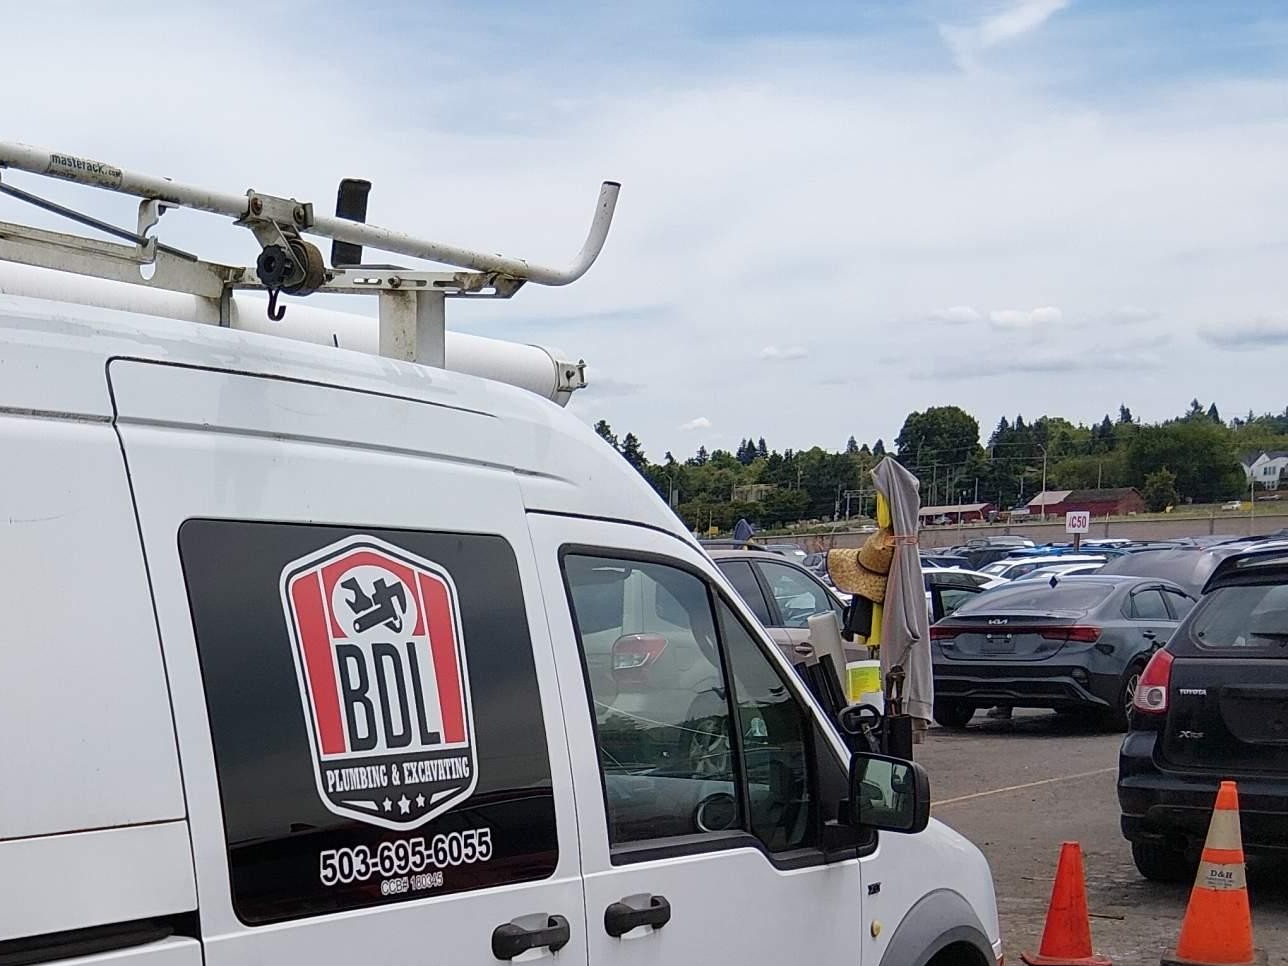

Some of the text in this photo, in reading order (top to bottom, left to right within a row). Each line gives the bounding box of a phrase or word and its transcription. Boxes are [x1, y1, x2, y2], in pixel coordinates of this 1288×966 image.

[336, 642, 441, 752] BDL
[1179, 688, 1207, 696] TOYOTA
[326, 757, 470, 792] PLUMBING & EXCAVATING
[320, 828, 492, 886] 503-695-6055
[381, 871, 443, 895] CCB# 180345
